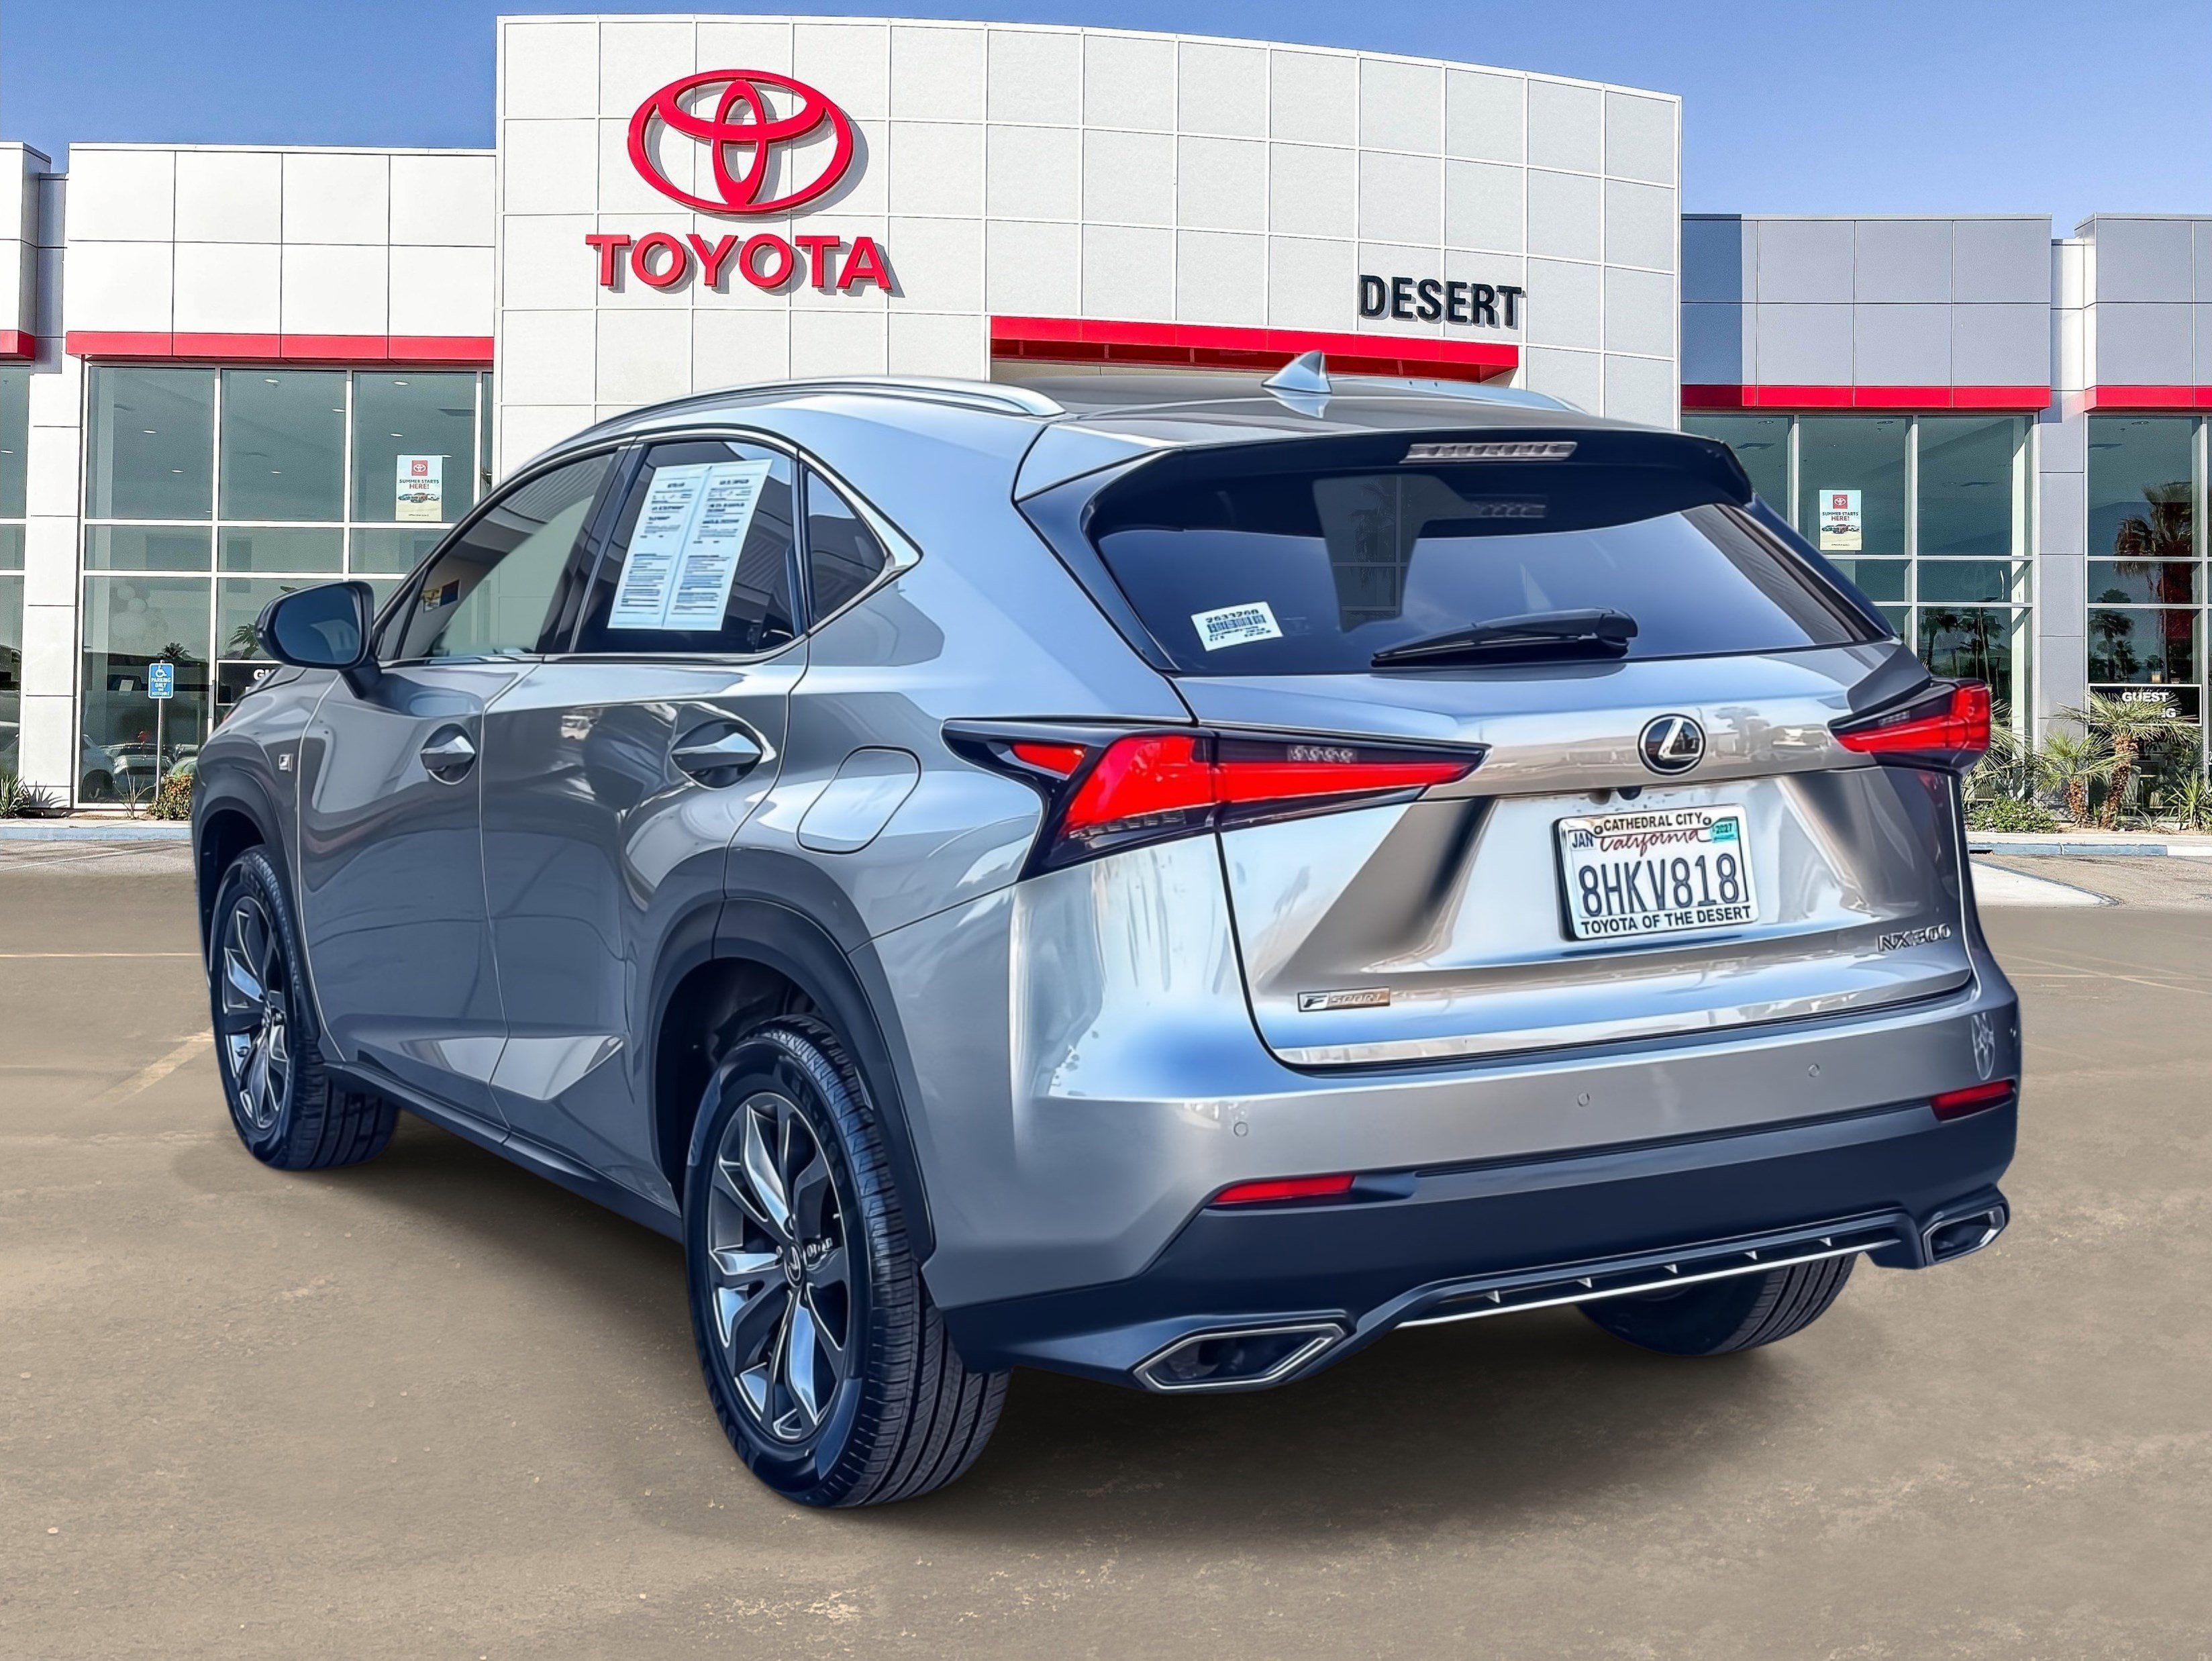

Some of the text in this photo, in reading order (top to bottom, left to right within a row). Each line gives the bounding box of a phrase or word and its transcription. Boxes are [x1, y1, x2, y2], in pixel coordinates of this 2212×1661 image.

[585, 232, 893, 290] TOYOTA
[1358, 274, 1523, 327] DESERT
[2121, 692, 2169, 703] GUEST
[1603, 812, 1703, 832] CATHEDRAL CITY
[1572, 832, 1594, 848] JAN
[1600, 829, 1712, 857] California
[1578, 852, 1740, 917] 8HKV818
[1581, 905, 1751, 935] TOYOTA OF THE DESERT
